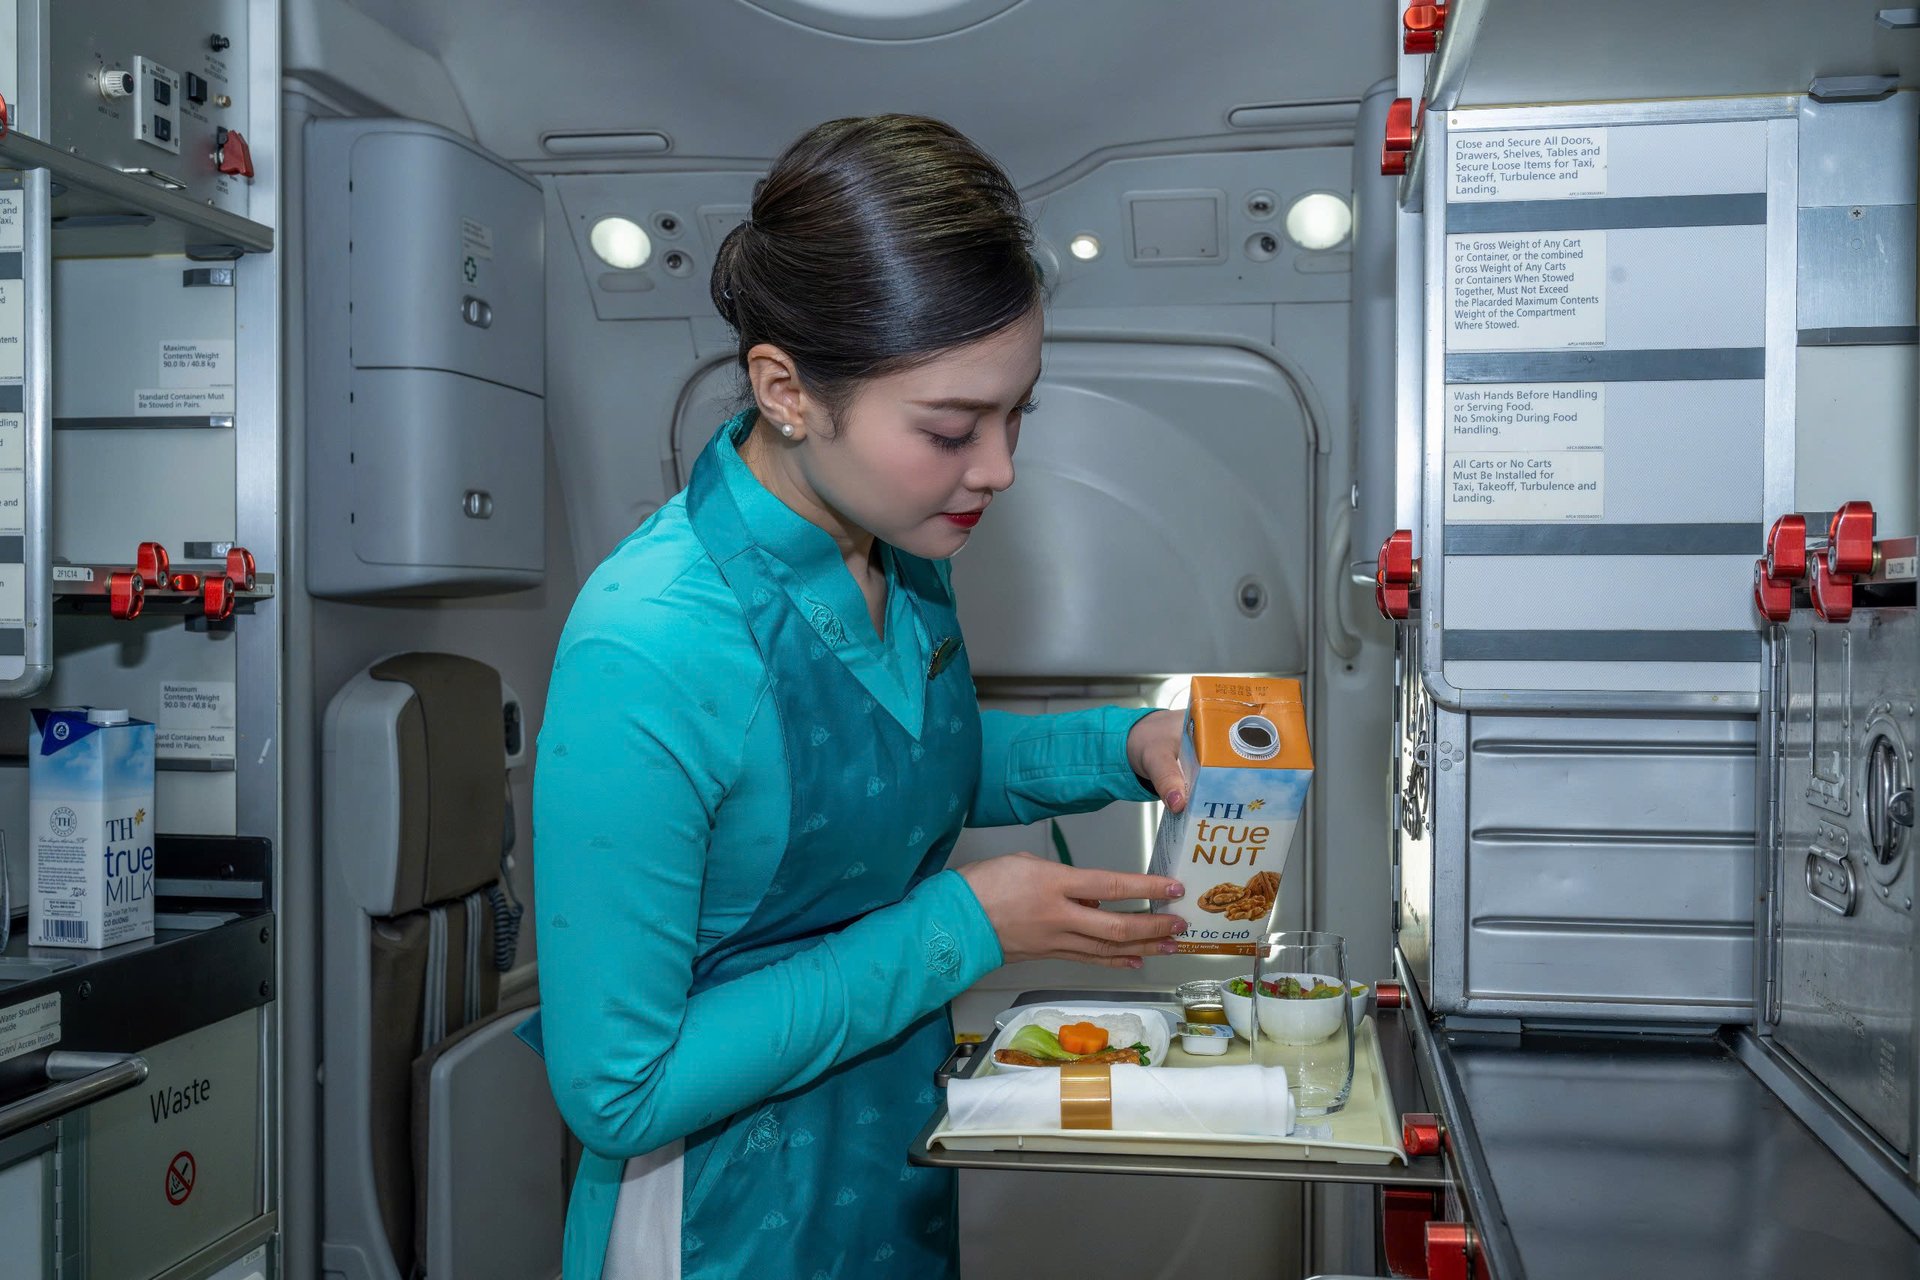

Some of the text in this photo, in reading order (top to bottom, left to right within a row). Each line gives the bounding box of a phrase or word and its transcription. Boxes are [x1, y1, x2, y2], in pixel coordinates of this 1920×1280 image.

[1456, 136, 1594, 149] Close and Secure All Doors,
[1456, 147, 1600, 160] Drawers, Shelves, Tables and
[1456, 159, 1595, 172] Secure Loose Items for Taxi,
[1456, 172, 1578, 183] Takeoff, Turbulence and
[1456, 186, 1499, 195] Landing.
[3, 205, 17, 214] and
[0, 216, 13, 225] axi,
[1455, 239, 1581, 251] The Gross Weight of Any Cart
[1467, 253, 1510, 262] Container,
[1525, 252, 1539, 260] the
[1542, 251, 1583, 259] combined
[1455, 262, 1566, 274] Gross Weight of Any Carts
[1455, 274, 1574, 285] or Containers When Stowed
[1455, 285, 1568, 297] Together, Must Not Exceed
[1455, 296, 1599, 307] the Placarded Maximum Contents
[1455, 308, 1576, 320] Weight of the Compartment
[1455, 320, 1519, 329] Where Stowed.
[195, 352, 219, 360] Weight
[1454, 390, 1598, 400] Wash Hands Before Handling
[1467, 403, 1503, 413] Serving
[1506, 402, 1533, 411] Food.
[1454, 413, 1577, 424] No Smoking During Food
[1454, 426, 1501, 436] Handling.
[1453, 460, 1466, 468] All
[1470, 460, 1493, 468] Carts
[1510, 460, 1524, 468] No
[1527, 459, 1551, 468] Carts
[1453, 470, 1554, 480] Must Be Installed for
[1453, 481, 1596, 492] Taxi, Takeoff, Turbulence and
[1453, 494, 1495, 504] Landing.
[208, 702, 216, 710] kg
[1204, 801, 1244, 820] TH
[105, 817, 134, 842] TH
[1197, 820, 1270, 843] true
[1192, 845, 1266, 866] NUT
[104, 846, 153, 878] true
[106, 871, 154, 906] MILK
[150, 1078, 210, 1124] Waste
